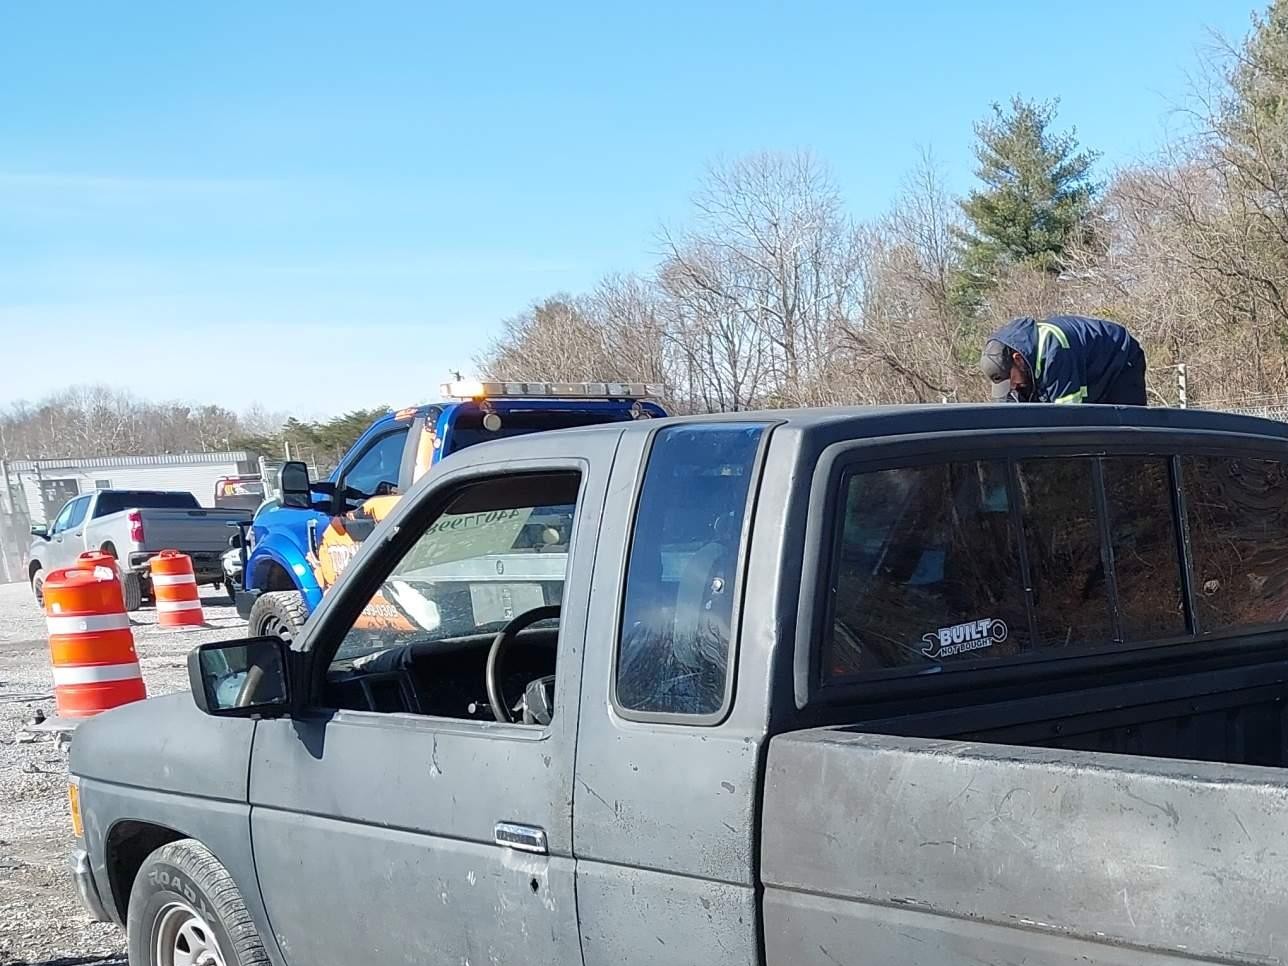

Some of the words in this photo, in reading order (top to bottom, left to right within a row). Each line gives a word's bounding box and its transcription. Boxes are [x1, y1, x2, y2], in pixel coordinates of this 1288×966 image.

[938, 618, 992, 646] BUILT
[940, 646, 960, 658] NOT
[960, 638, 993, 653] BOUGHT
